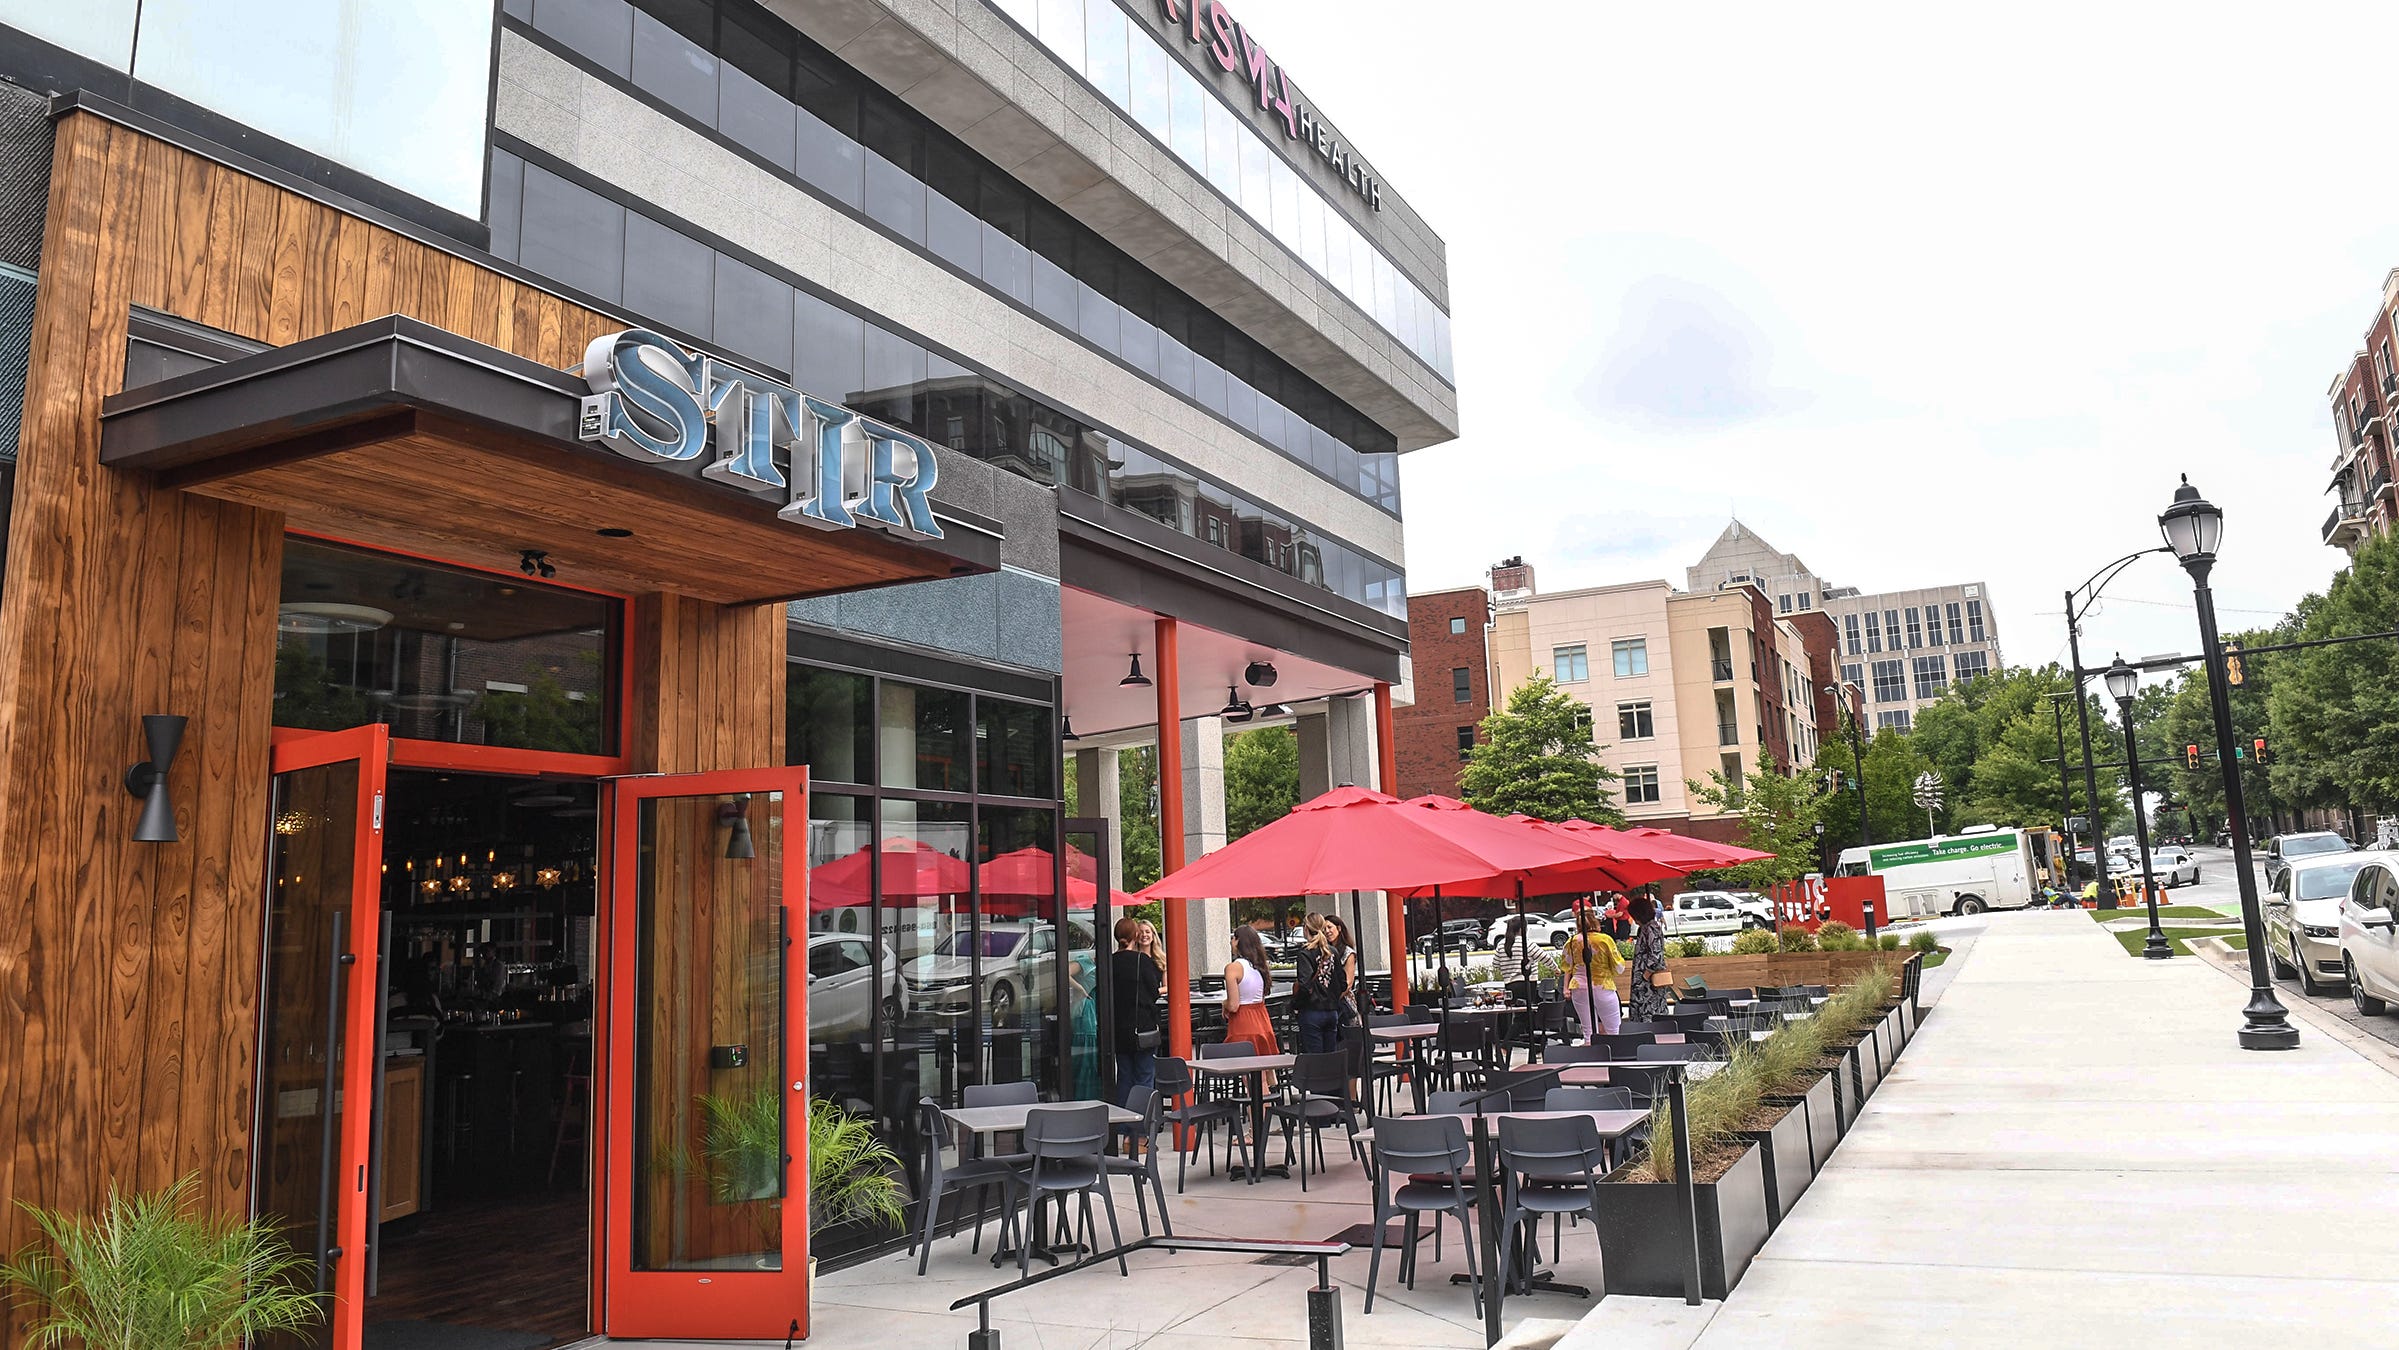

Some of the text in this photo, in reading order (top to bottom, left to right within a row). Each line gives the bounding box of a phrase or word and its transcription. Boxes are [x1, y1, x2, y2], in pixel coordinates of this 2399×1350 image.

[1296, 103, 1381, 213] HEALTH
[580, 328, 944, 541] STIR
[1947, 846, 1969, 854] charge.
[1970, 844, 1980, 852] Go
[1980, 842, 2005, 851] electric.
